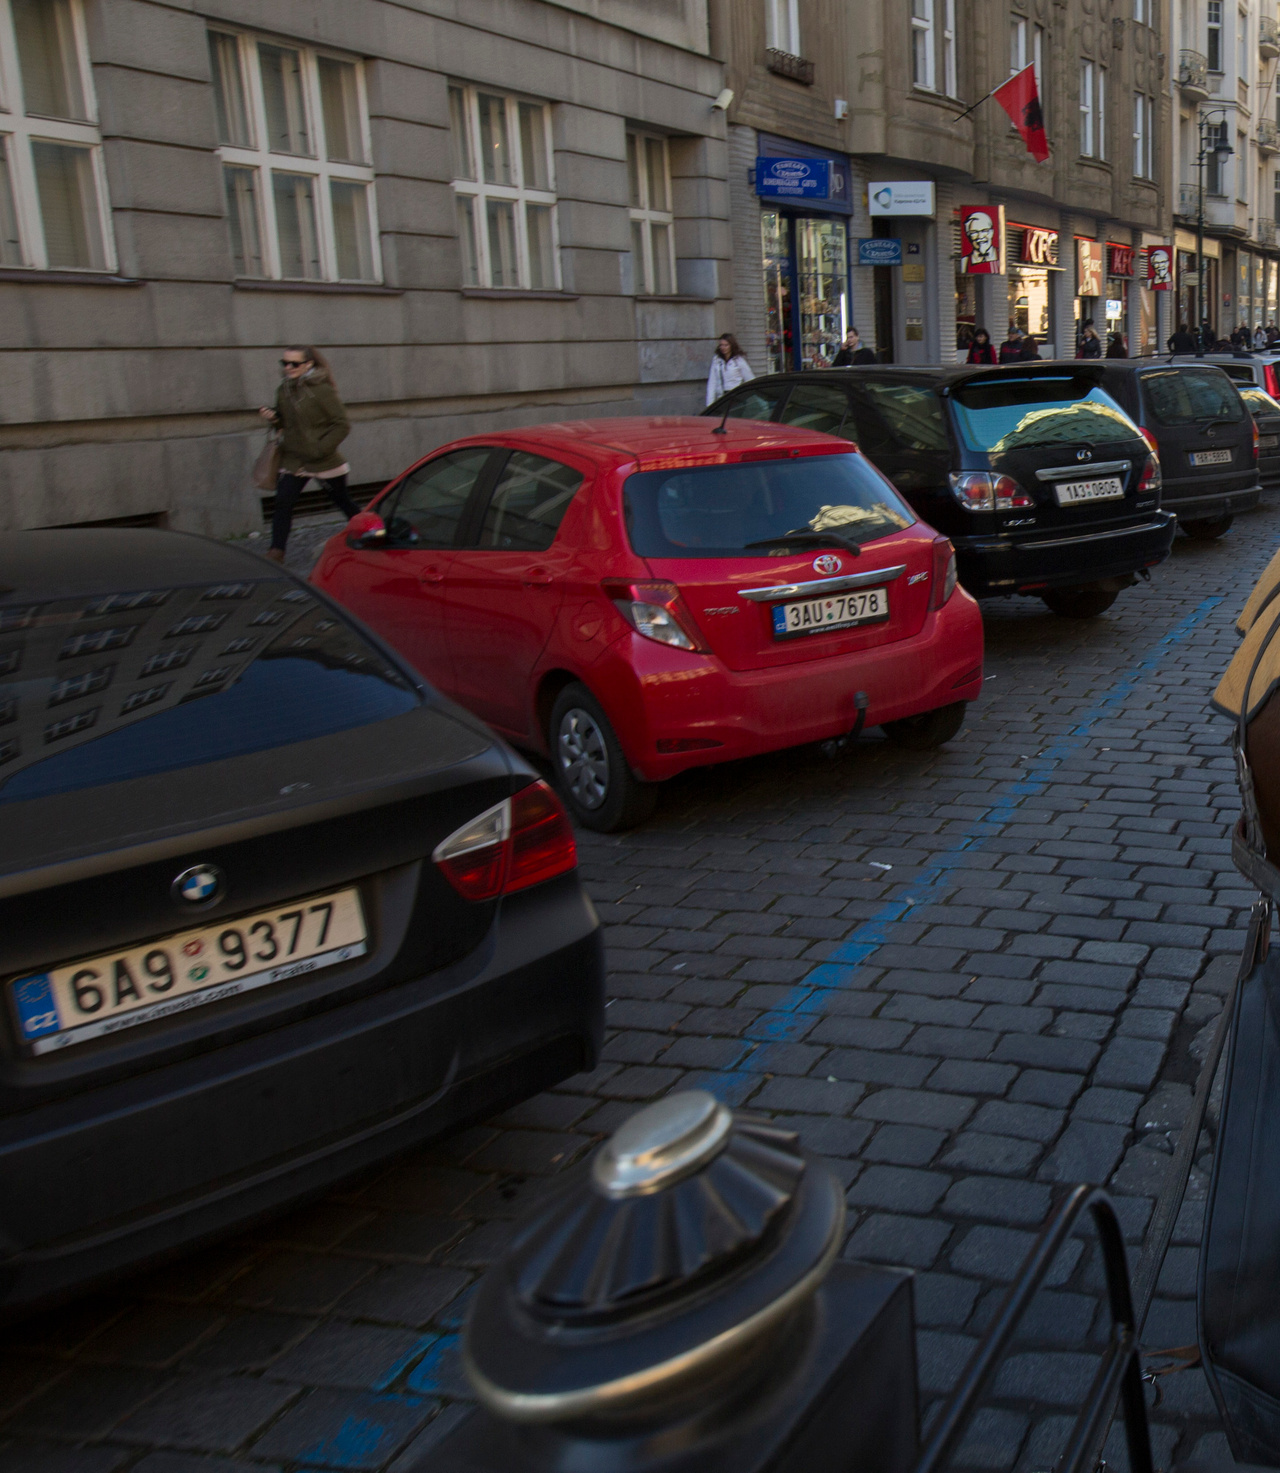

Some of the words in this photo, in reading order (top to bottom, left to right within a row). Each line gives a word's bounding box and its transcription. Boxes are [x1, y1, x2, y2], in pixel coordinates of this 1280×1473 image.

[1066, 484, 1086, 500] 1A3
[703, 606, 740, 616] TOYOTA
[789, 602, 824, 627] 3AU
[836, 594, 879, 620] 7678
[24, 1010, 57, 1033] CZ
[70, 948, 176, 1015] 6A9
[216, 901, 335, 972] 9377
